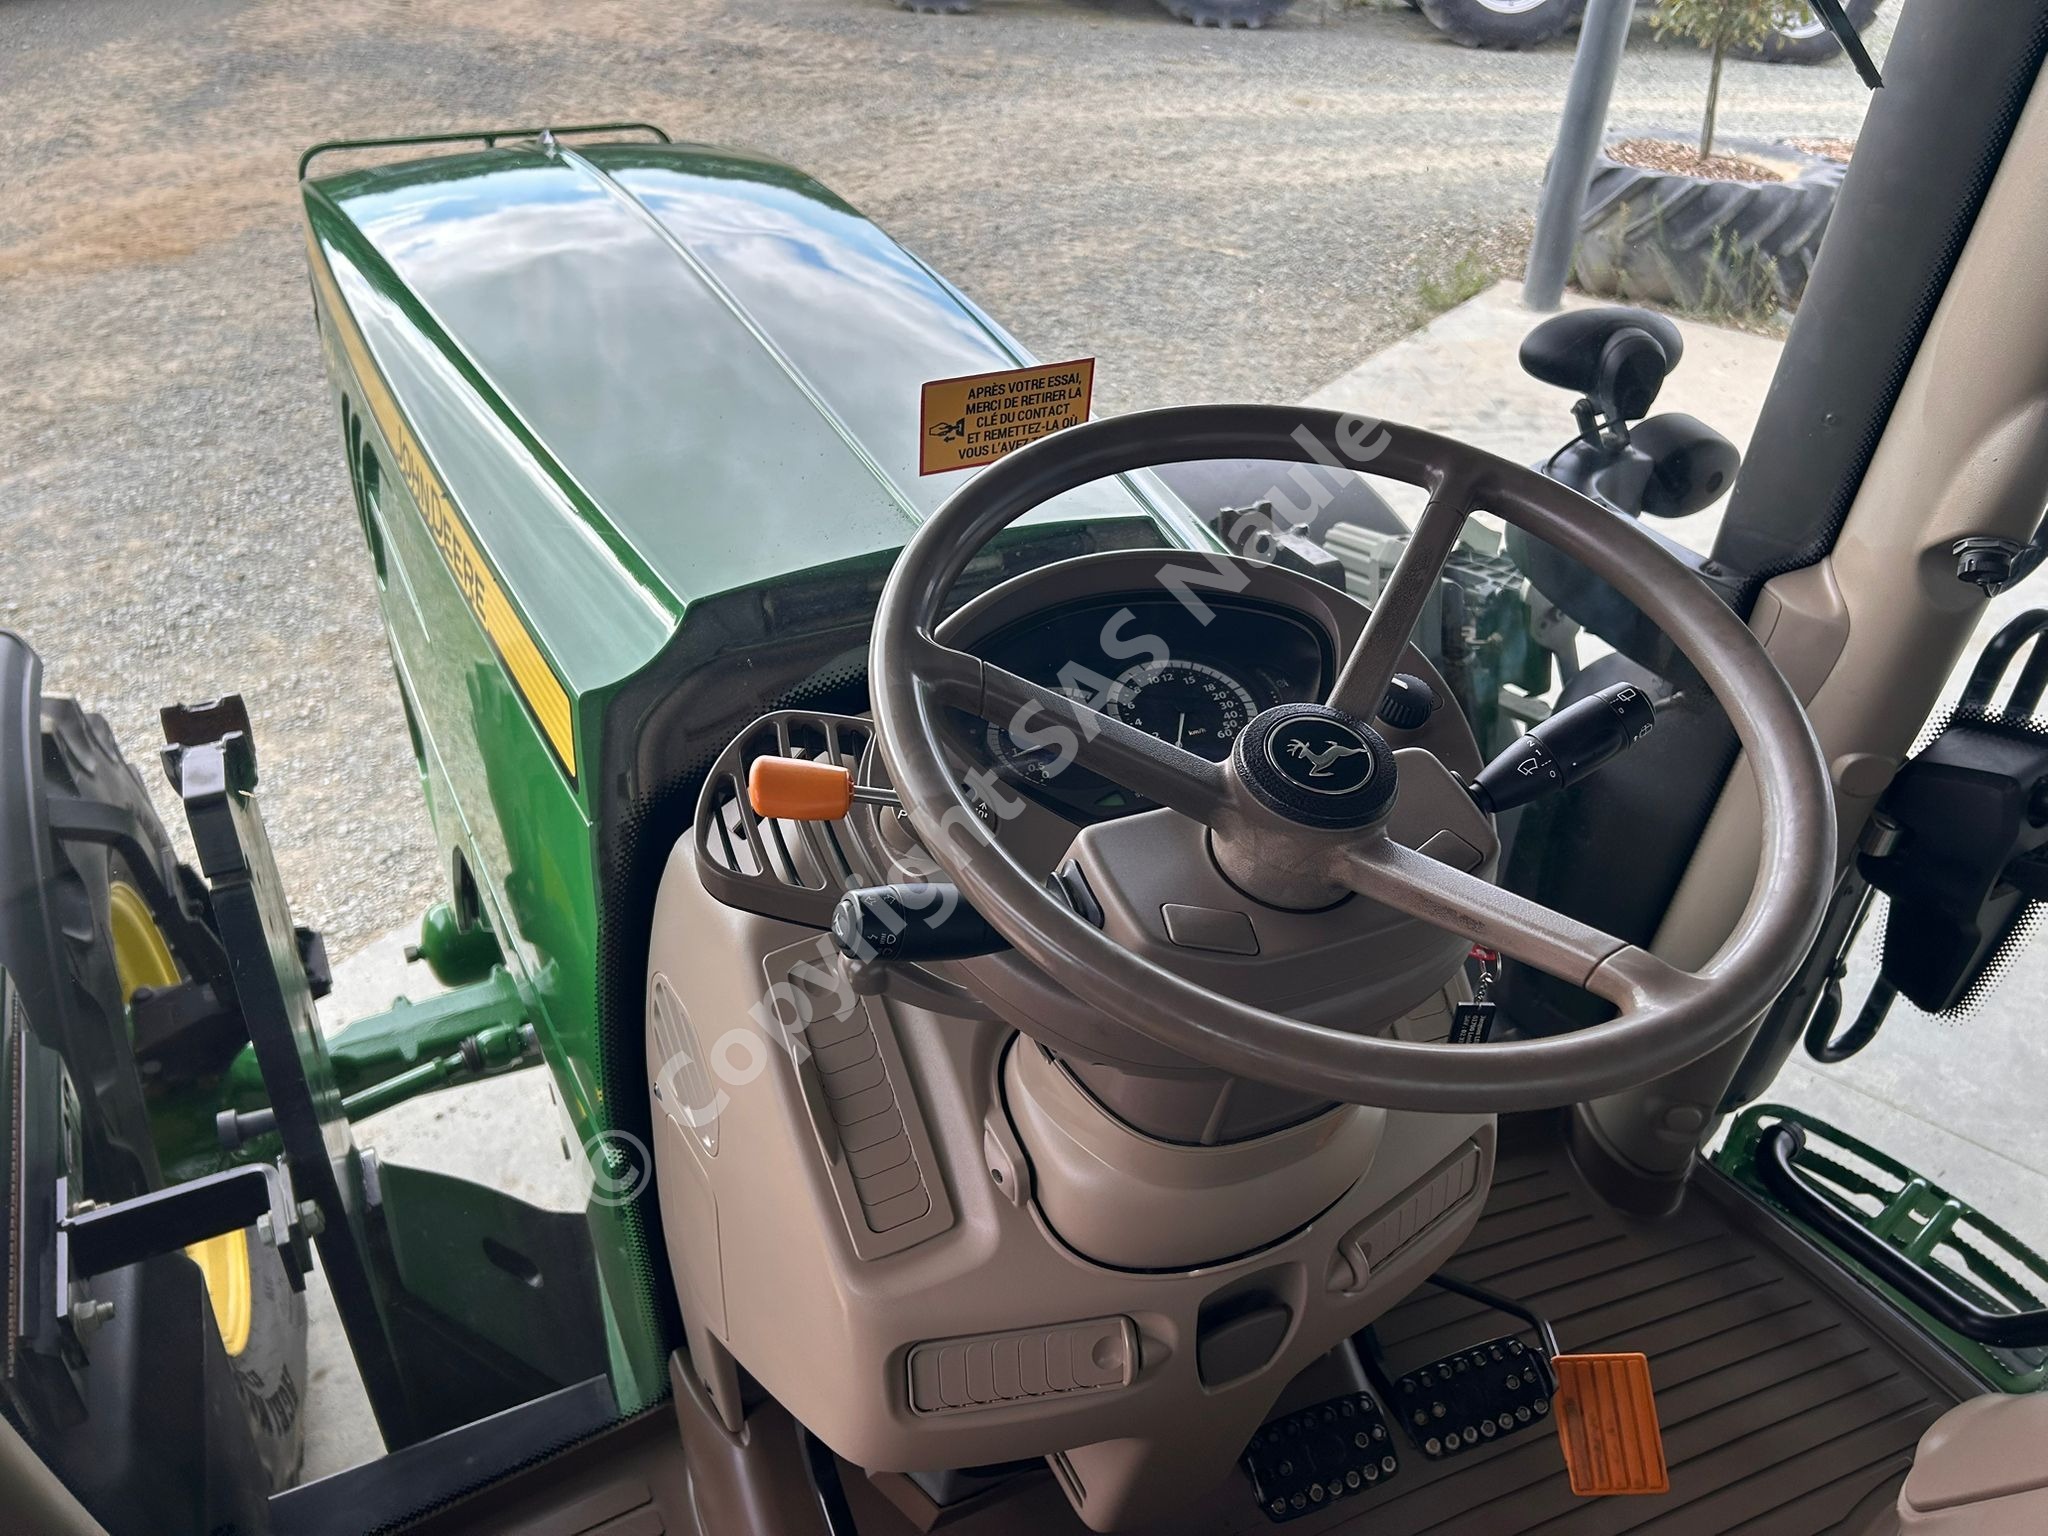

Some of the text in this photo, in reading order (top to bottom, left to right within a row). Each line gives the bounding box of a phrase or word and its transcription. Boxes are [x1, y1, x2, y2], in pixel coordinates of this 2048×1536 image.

[968, 372, 1082, 400] APRÈS VOTRE ESSAI,
[966, 387, 1082, 416] MERCI DE RETIRER LA
[976, 403, 1070, 428] CLÉ DU CONTACT
[967, 416, 1078, 444] ET REMETTEZ-LA OÙ
[959, 445, 989, 459] VOUS
[398, 425, 487, 621] JOHN DEERE
[1147, 676, 1160, 684] 10
[1161, 673, 1174, 682] 12
[1183, 676, 1196, 685] 15
[1202, 683, 1216, 692] 18
[1211, 691, 1227, 700] 20
[1127, 702, 1135, 710] 6
[1219, 700, 1234, 709] 30
[1223, 710, 1238, 719] 40
[1135, 718, 1143, 726] 4
[1222, 720, 1238, 729] 50
[1217, 729, 1233, 739] 60
[1527, 740, 1535, 748] 2
